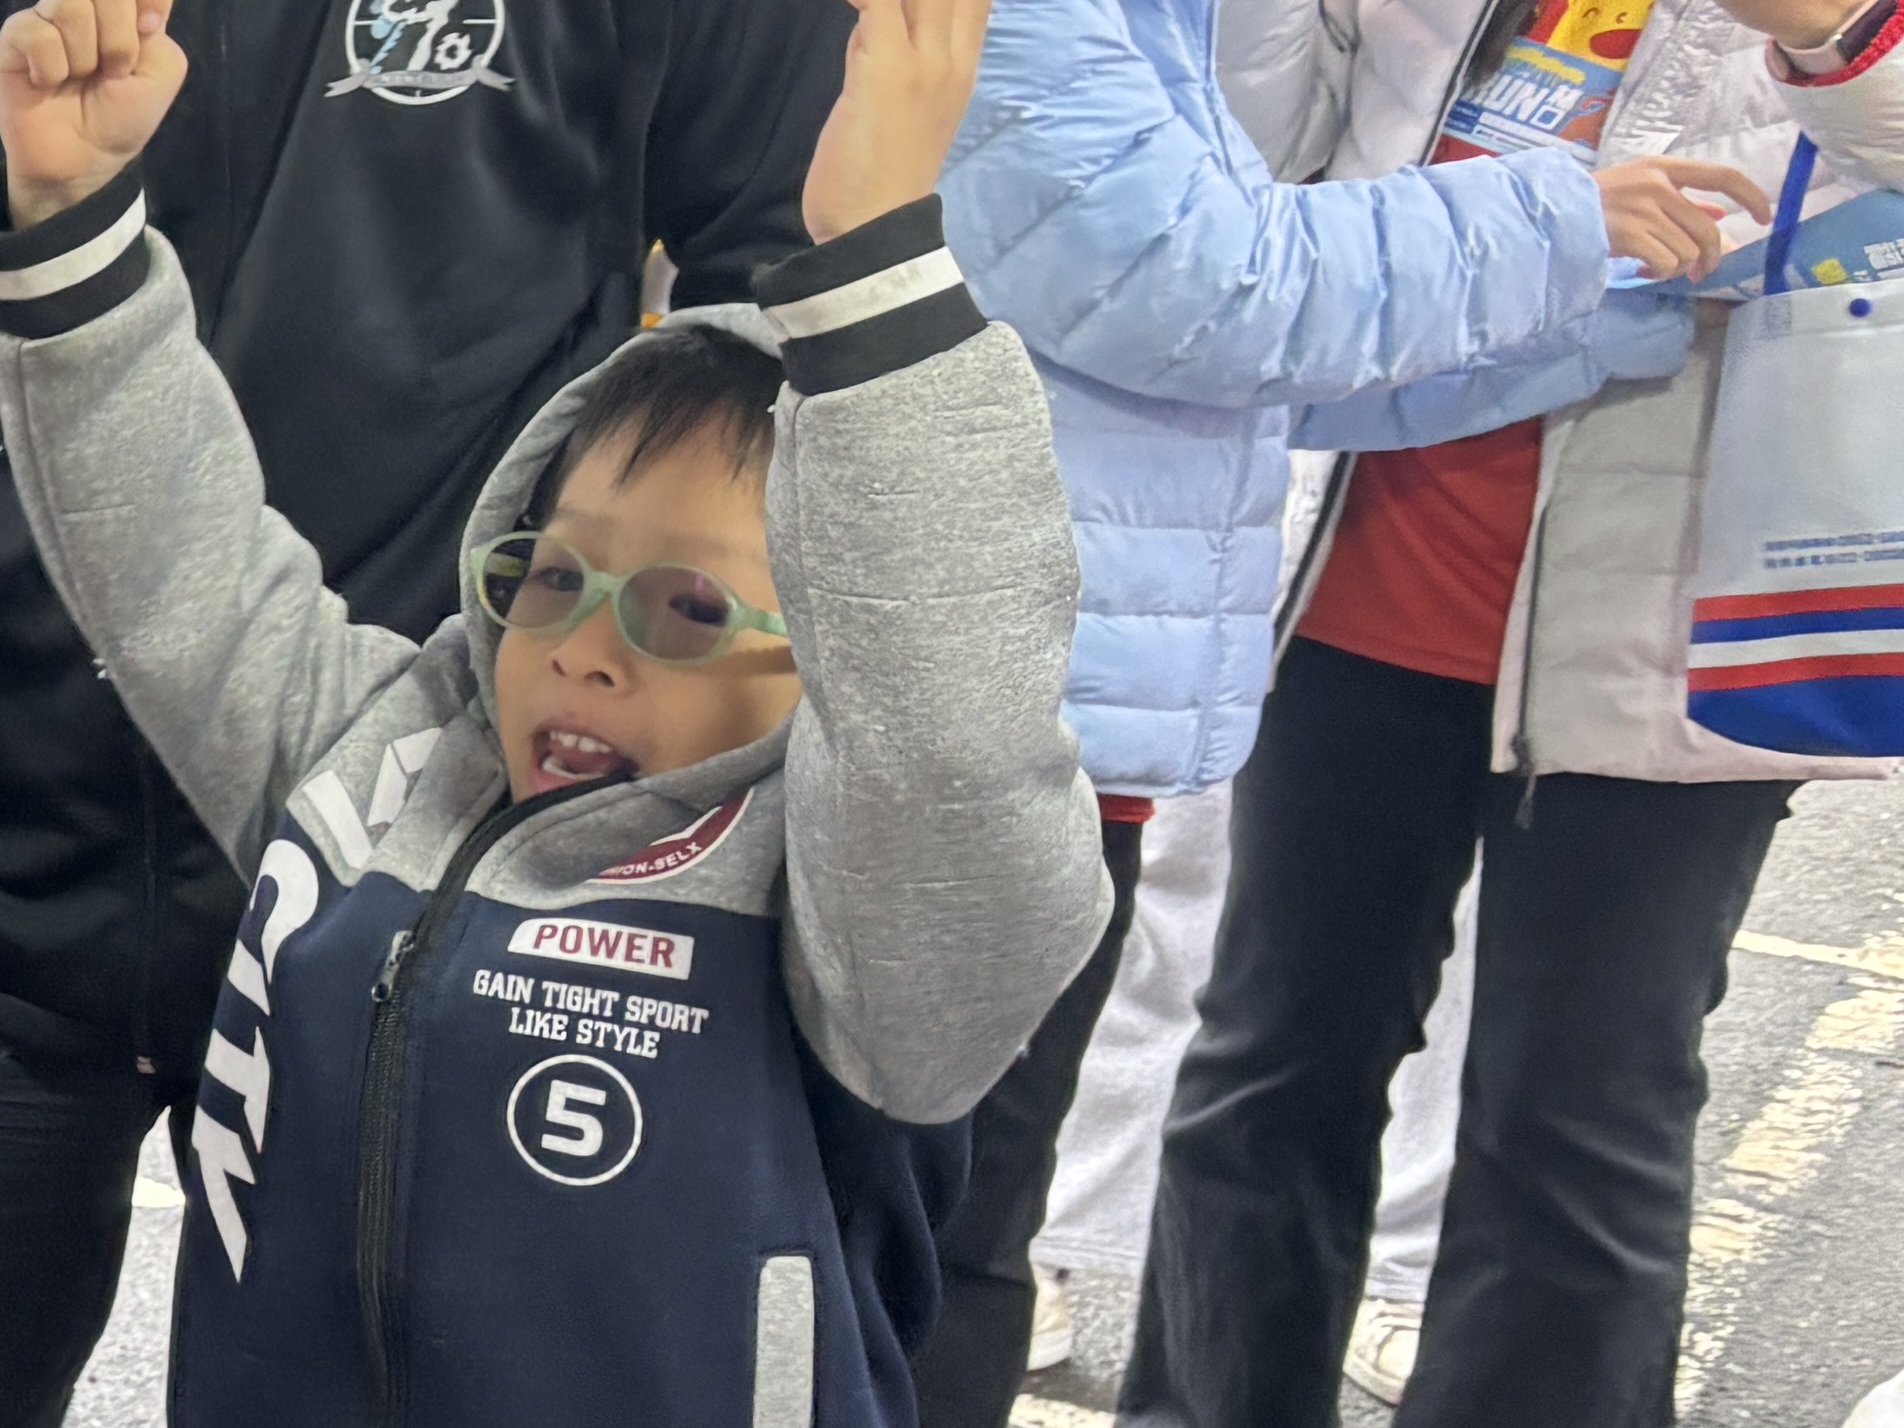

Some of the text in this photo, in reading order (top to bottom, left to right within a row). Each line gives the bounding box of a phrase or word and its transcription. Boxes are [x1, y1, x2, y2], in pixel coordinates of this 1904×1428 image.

[533, 924, 676, 969] POWER
[473, 969, 710, 1034] GAIN TIGHT SPORT
[509, 1007, 661, 1059] LIKE STYLE
[541, 1079, 607, 1157] 5
